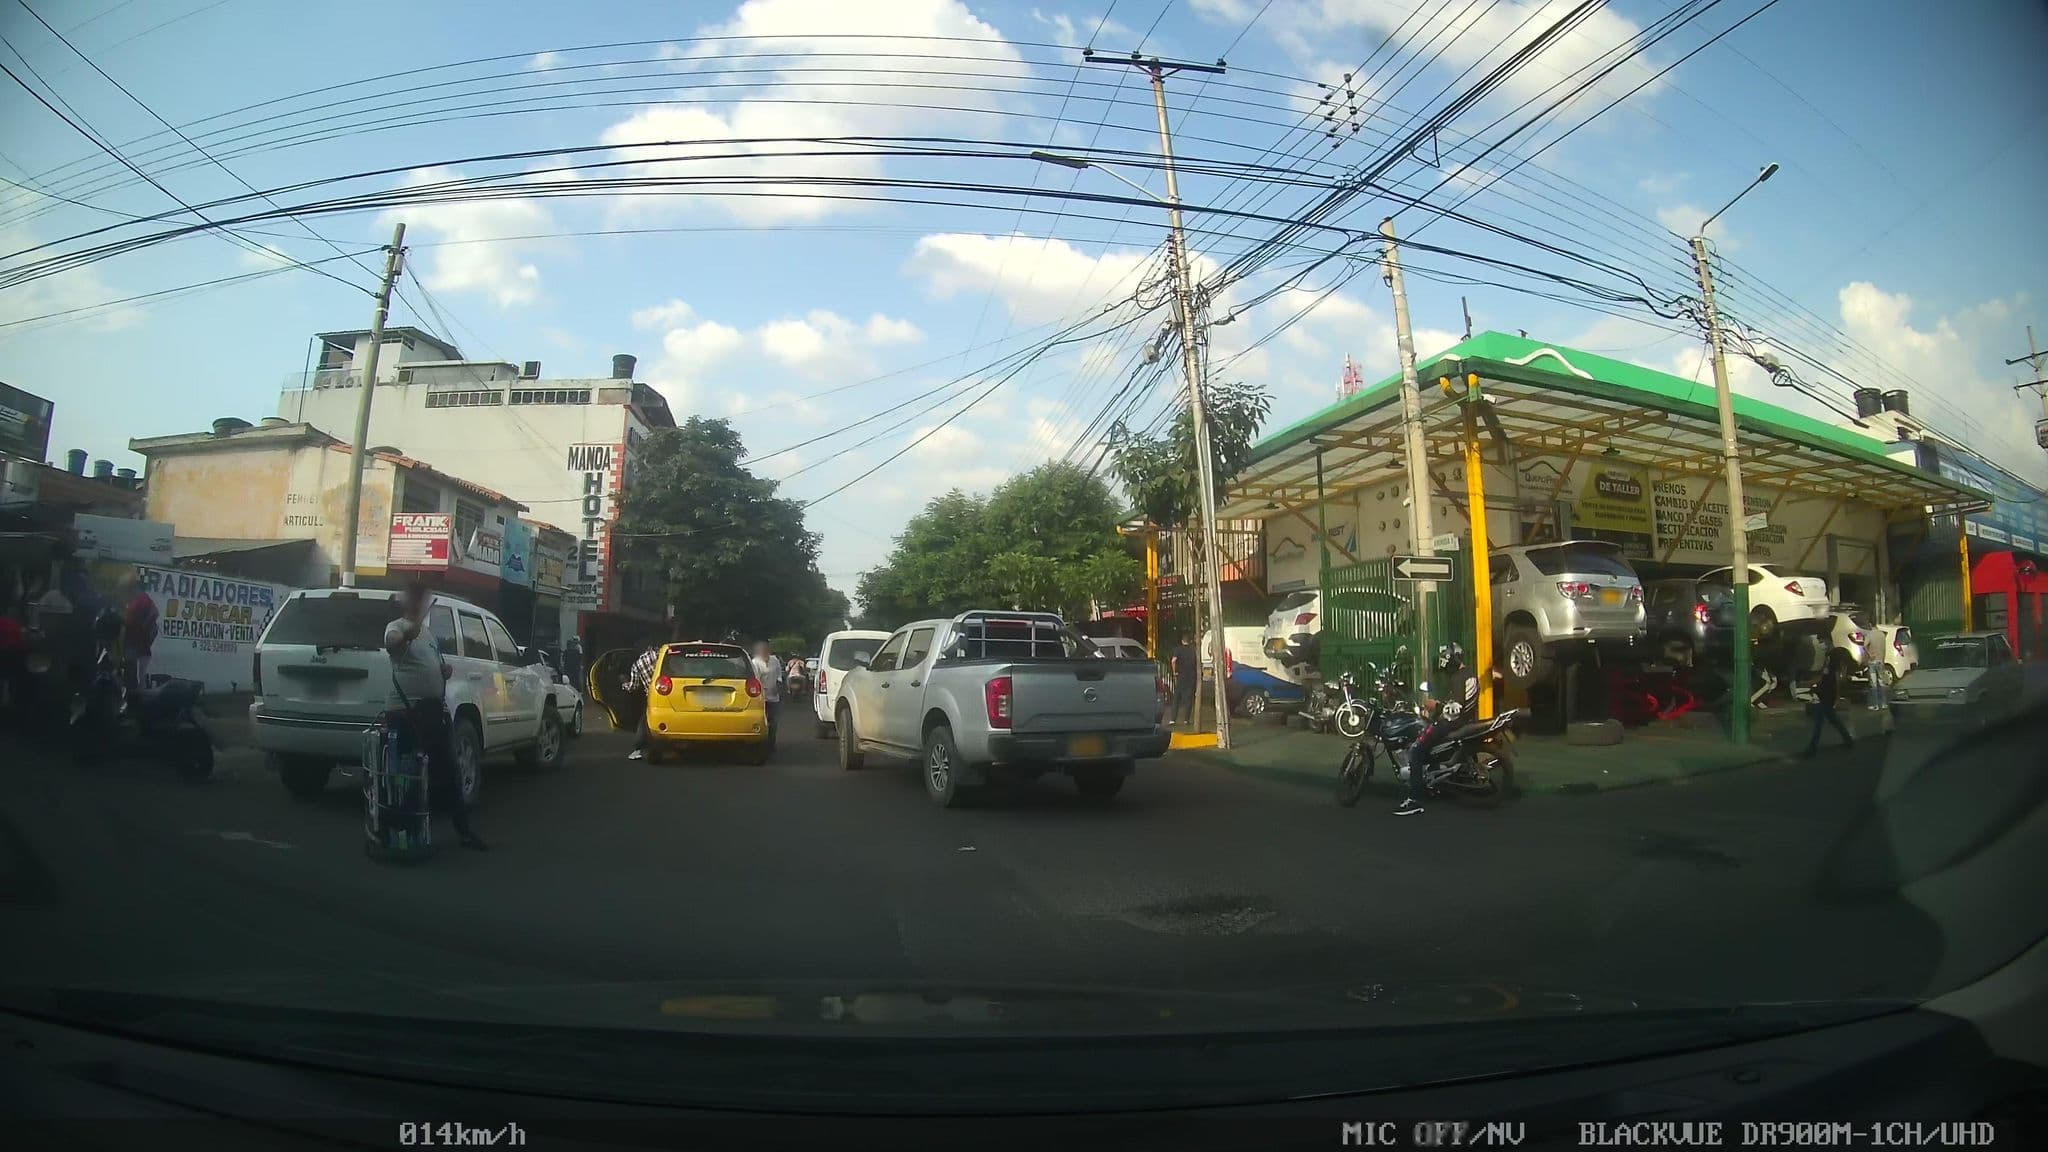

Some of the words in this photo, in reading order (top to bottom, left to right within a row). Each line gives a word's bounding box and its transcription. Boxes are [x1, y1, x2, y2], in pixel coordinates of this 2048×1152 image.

[568, 446, 611, 471] MANOA
[1655, 495, 1688, 509] CAMBIO
[1702, 503, 1729, 515] ACEITE
[284, 515, 323, 527] ARTICUL
[392, 515, 448, 526] FRANK
[579, 472, 603, 582] HOTEL
[1699, 515, 1724, 528] GASES
[148, 570, 273, 607] RADIADORES
